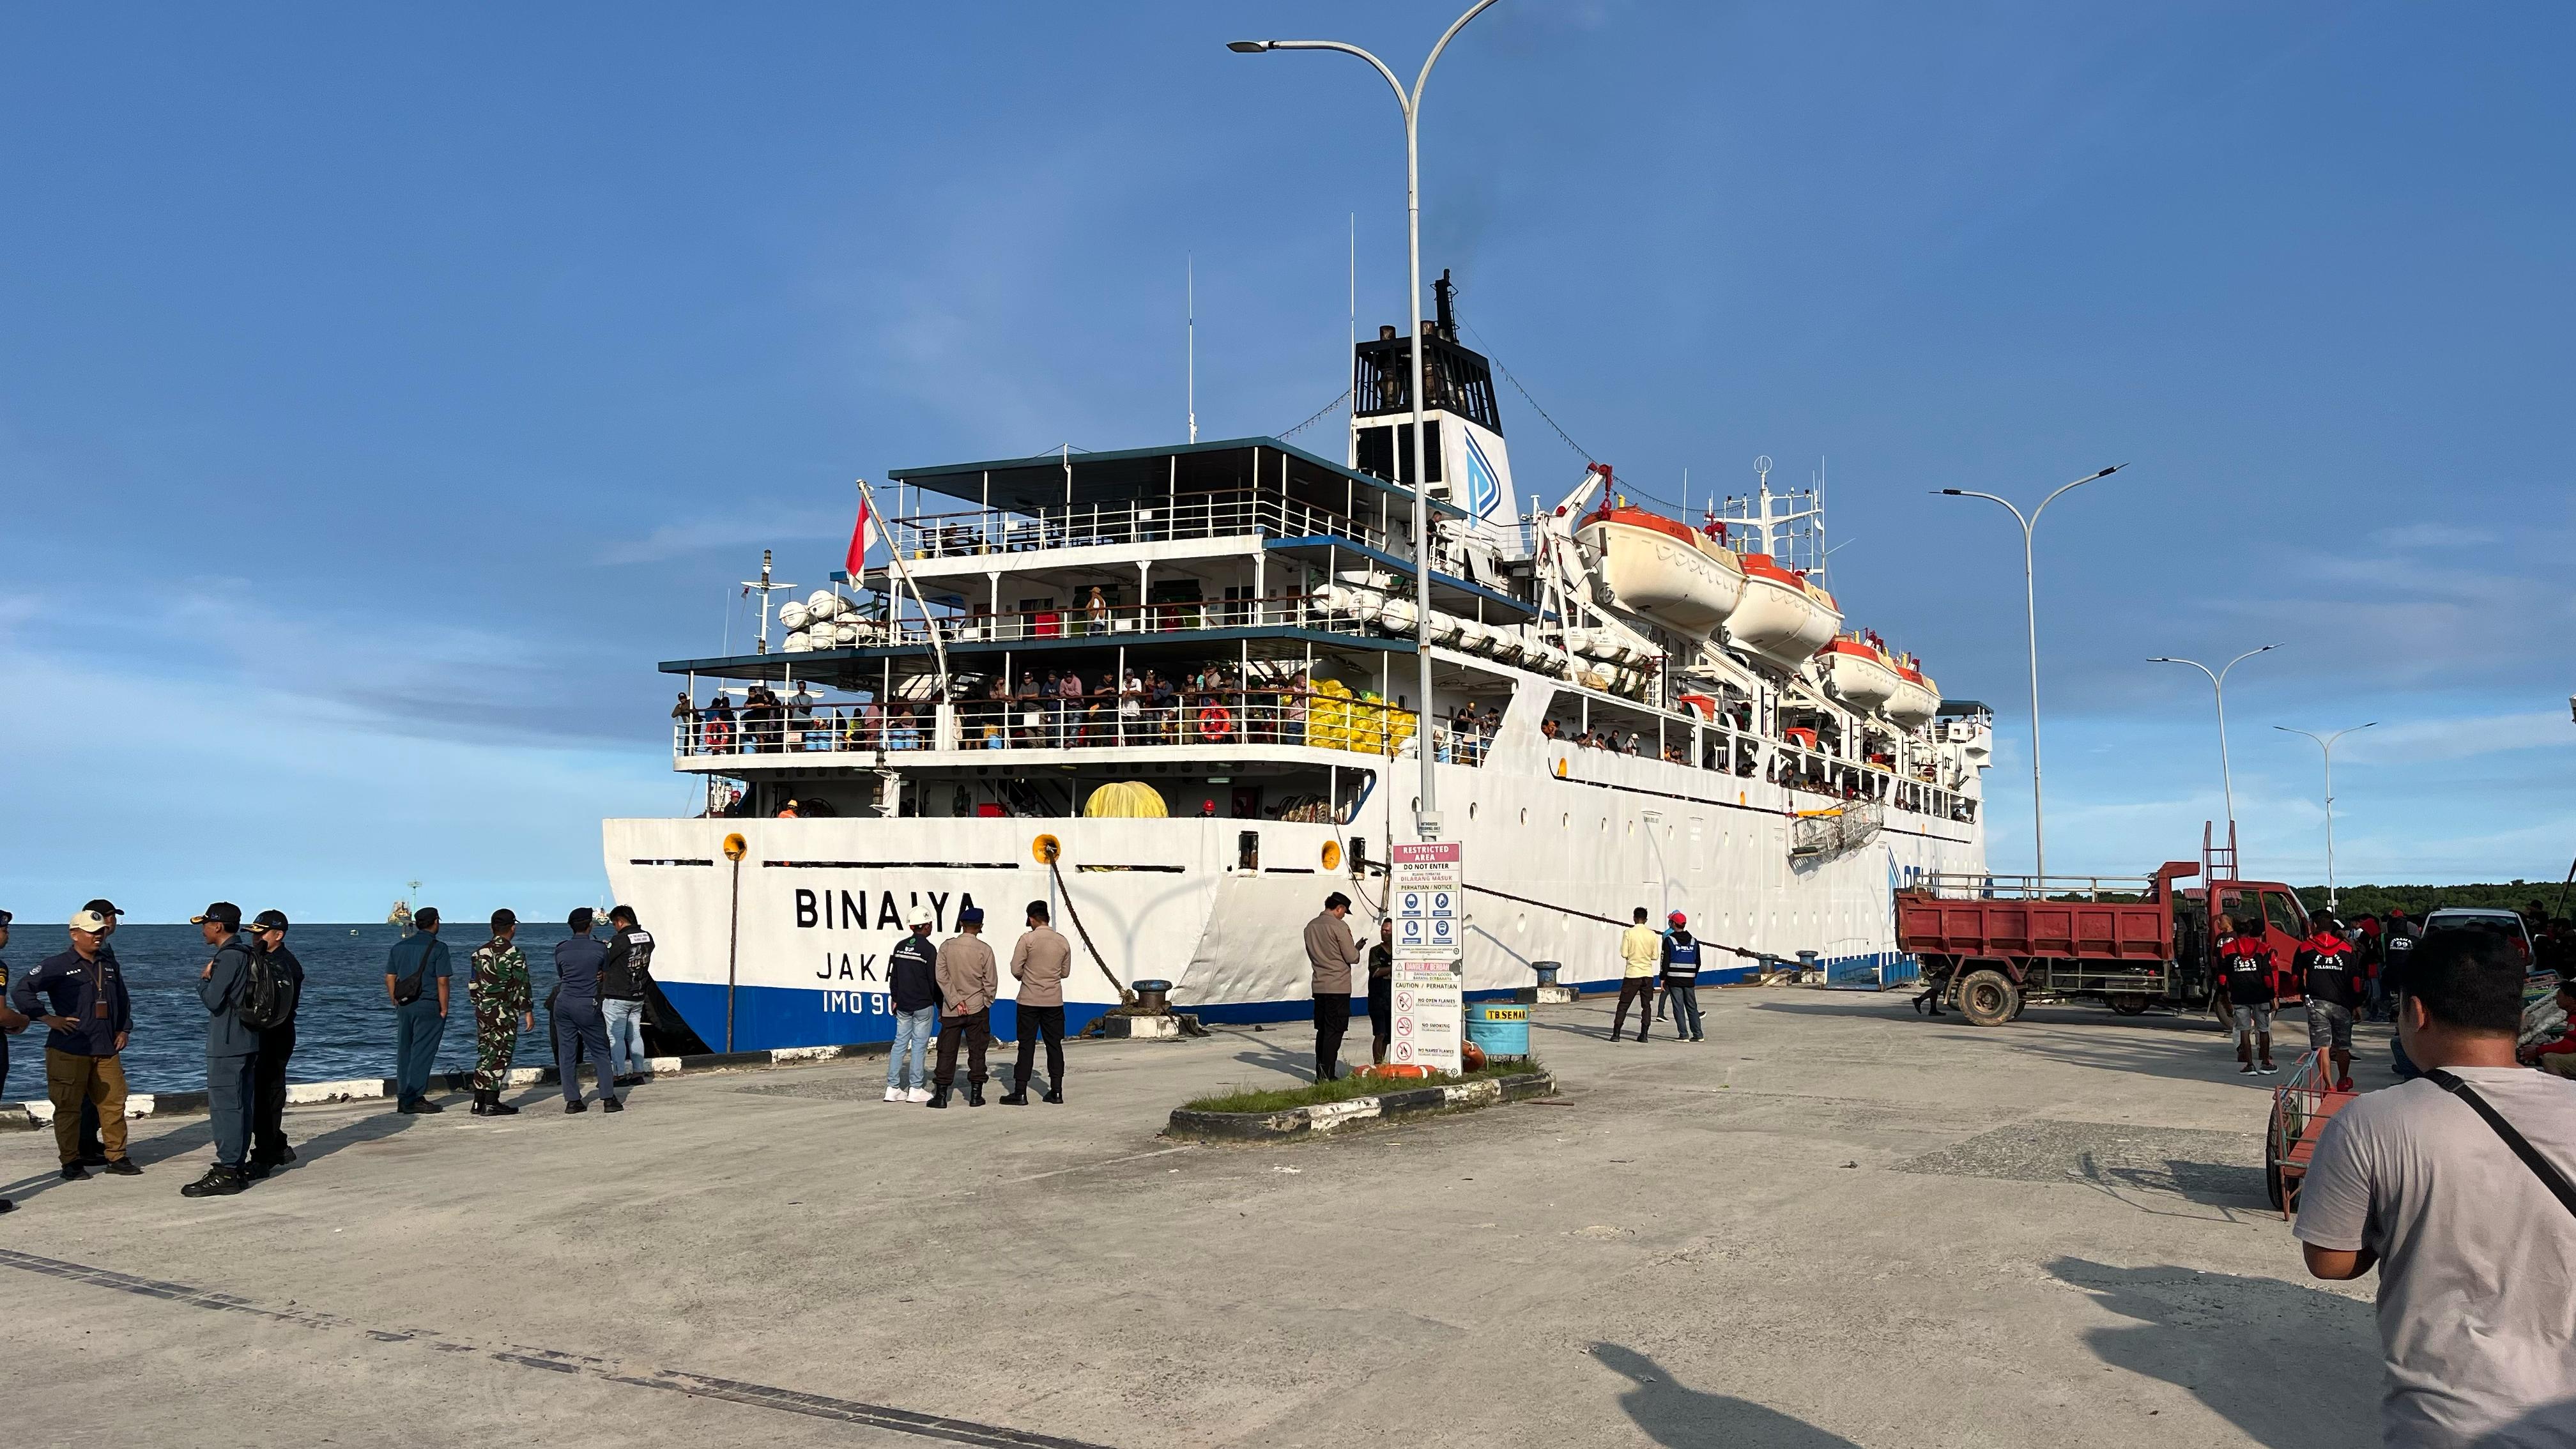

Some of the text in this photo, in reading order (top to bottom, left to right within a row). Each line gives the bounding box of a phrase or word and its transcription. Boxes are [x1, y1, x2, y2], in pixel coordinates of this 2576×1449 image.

[1403, 845, 1449, 854] RESTRICTED
[1406, 962, 1425, 971] DANGER
[1429, 963, 1450, 971] BERBAH
[824, 991, 862, 1014] IMO
